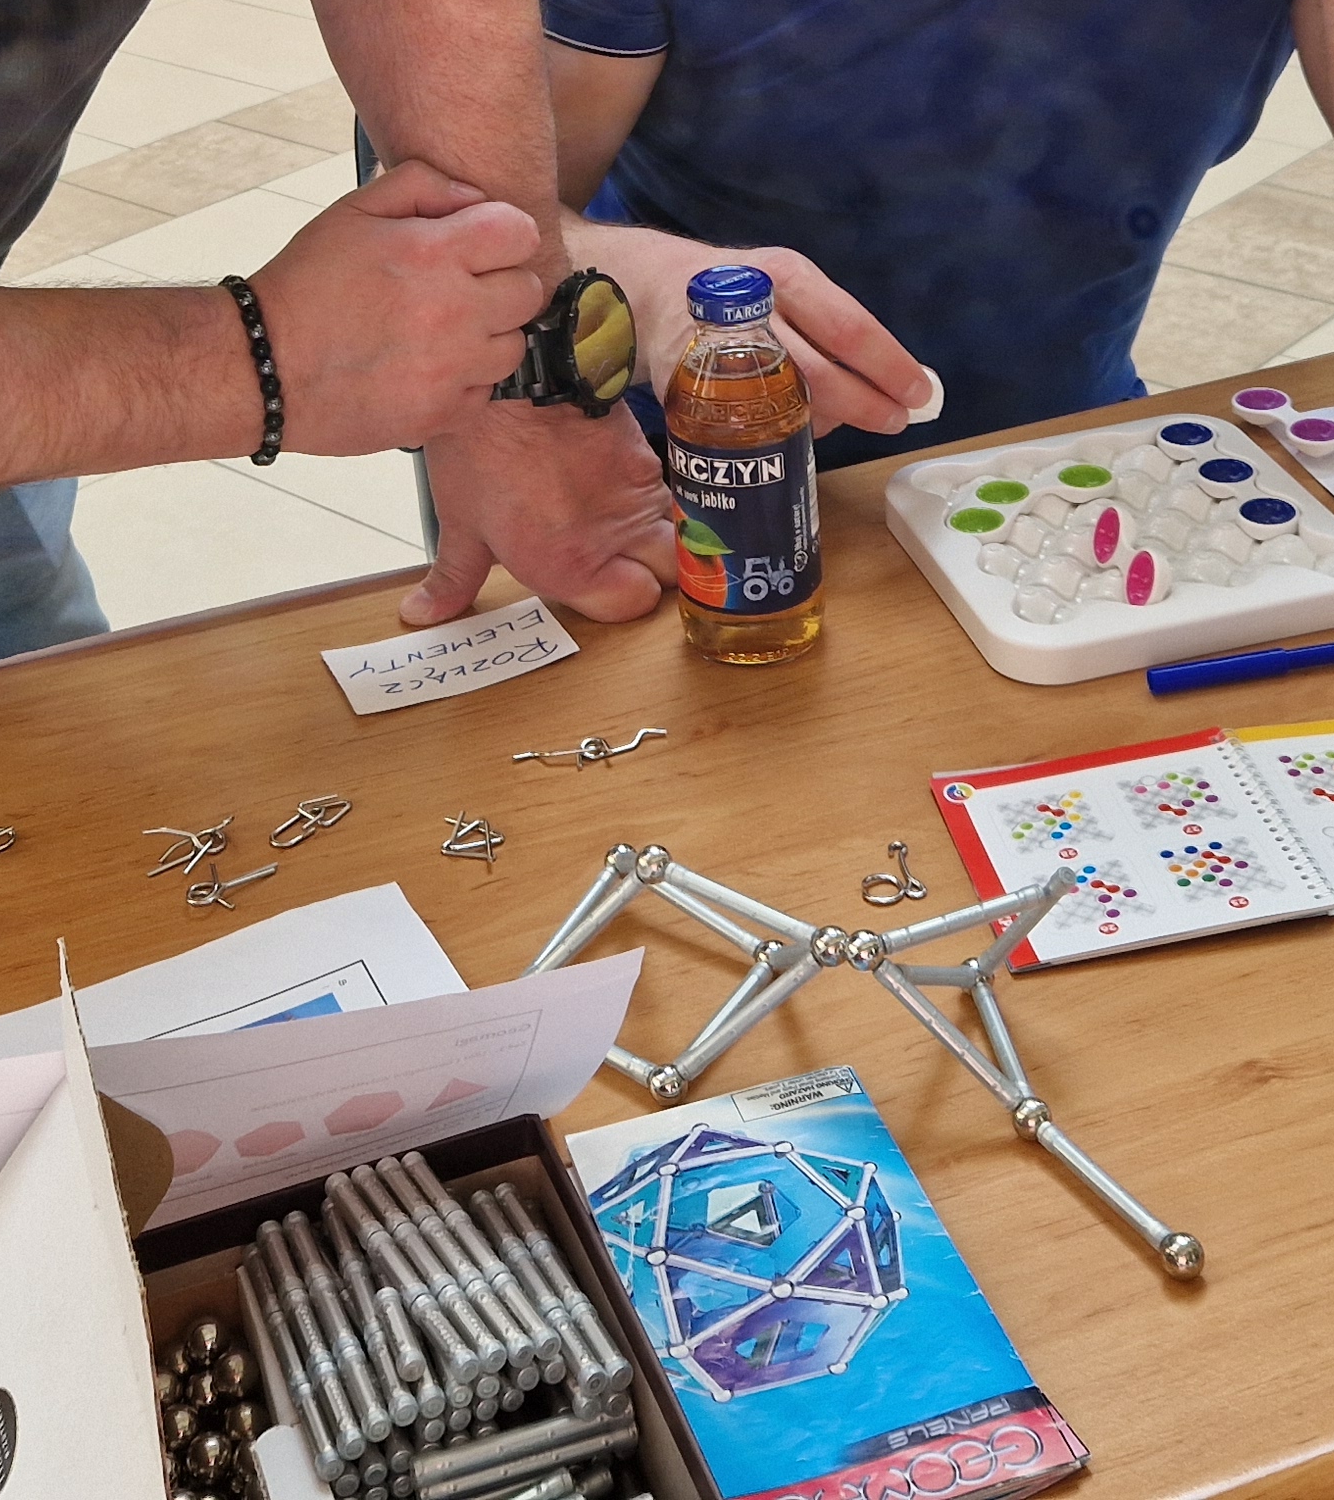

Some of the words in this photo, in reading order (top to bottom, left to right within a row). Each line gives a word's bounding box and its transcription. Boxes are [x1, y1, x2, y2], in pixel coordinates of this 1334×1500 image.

[349, 608, 544, 678] ELEMENTY
[771, 1090, 824, 1111] WARNING:
[888, 1398, 1010, 1448] PANELS
